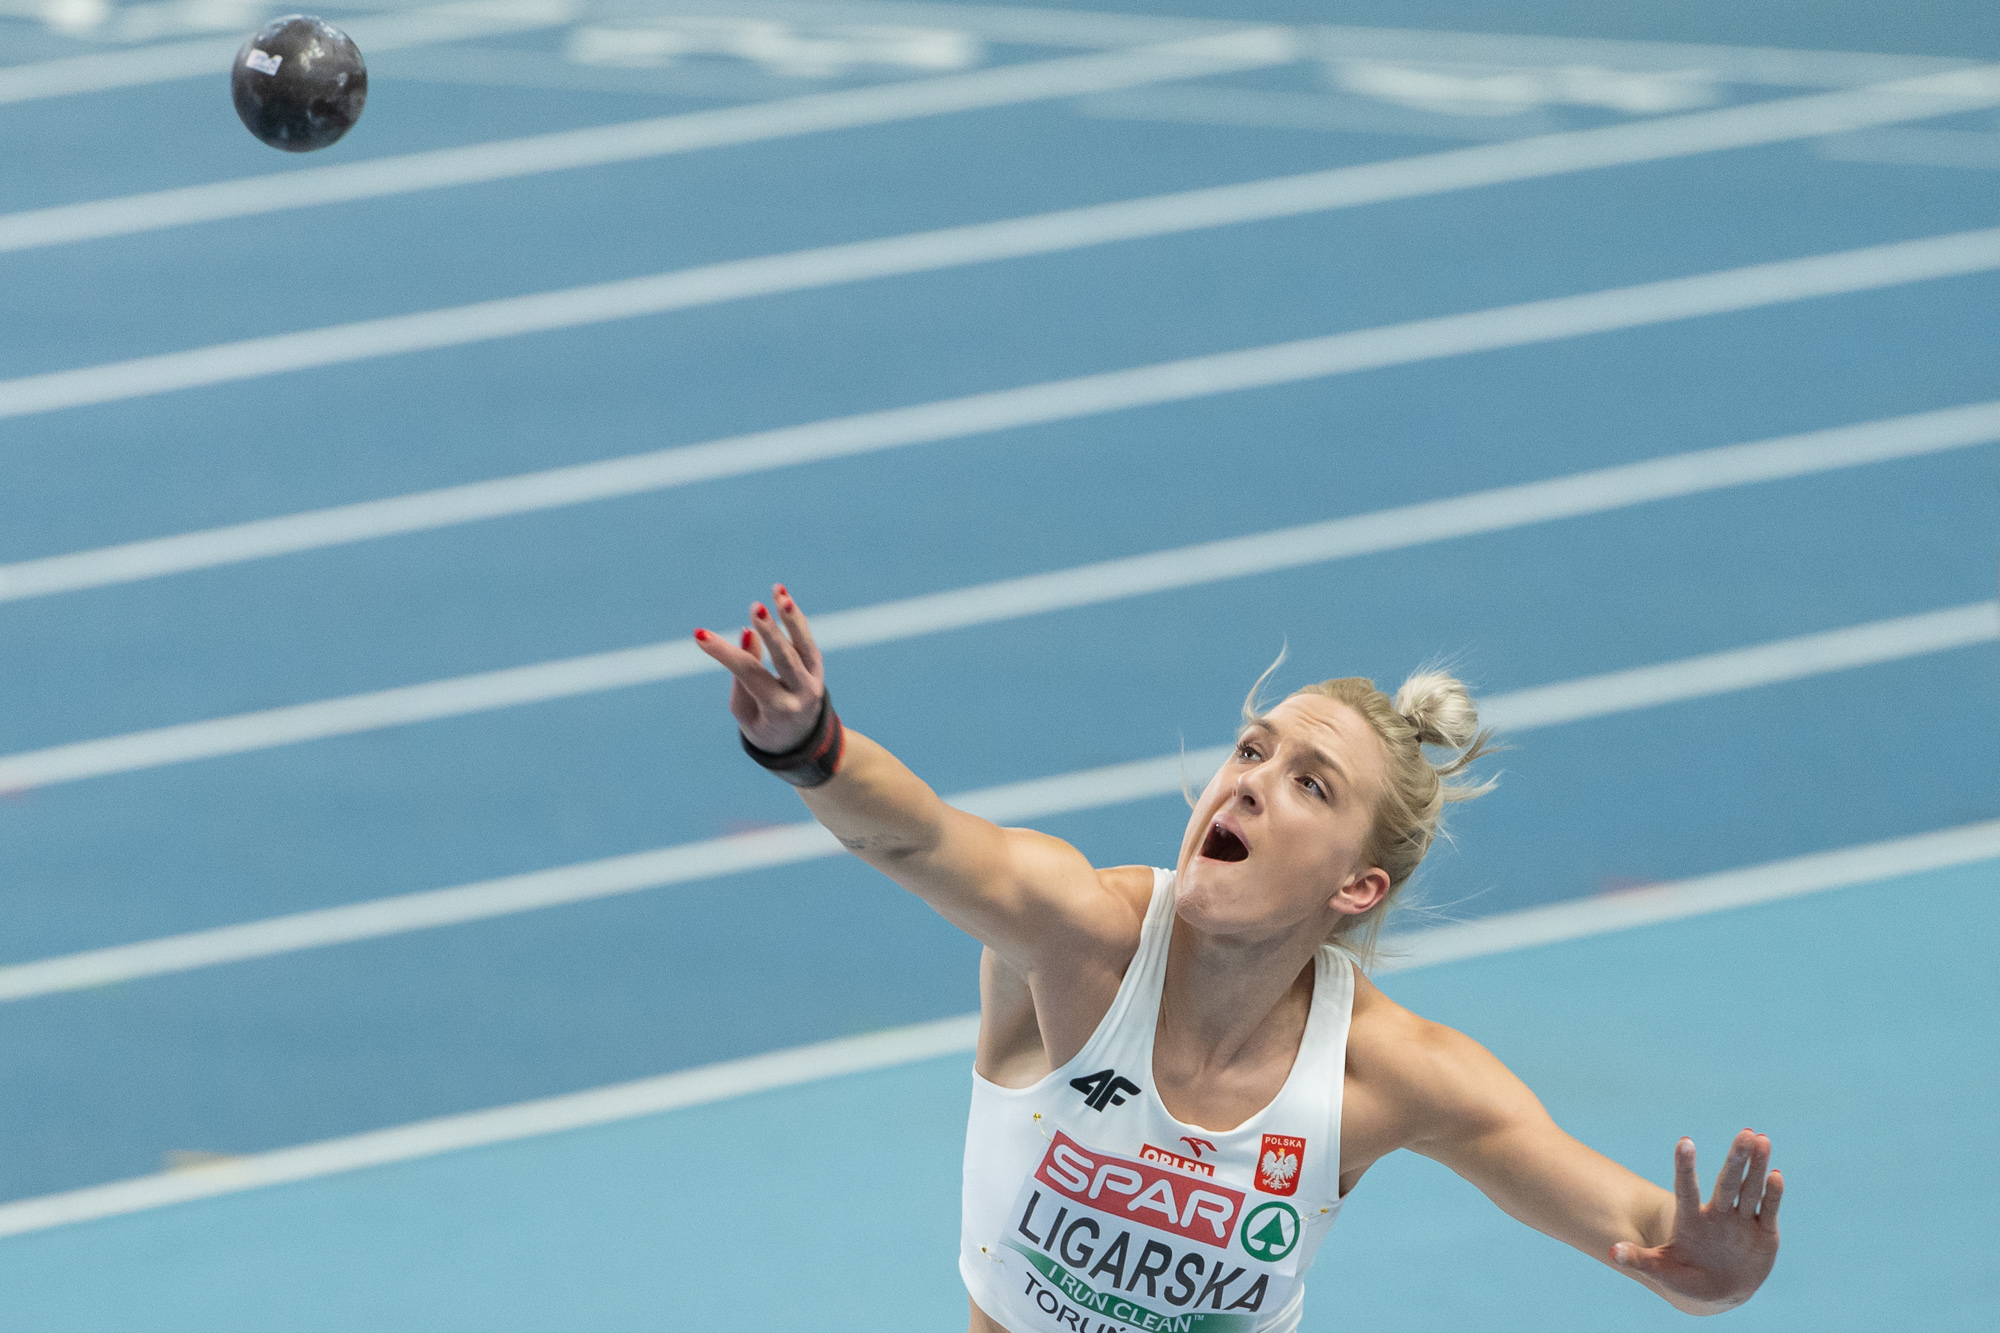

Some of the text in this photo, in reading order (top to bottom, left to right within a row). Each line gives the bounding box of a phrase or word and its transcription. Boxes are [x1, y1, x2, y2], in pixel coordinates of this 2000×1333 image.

[1265, 1136, 1302, 1148] POLSKA
[1046, 1143, 1235, 1239] SPAR
[1018, 1190, 1270, 1313] LIGARSKA
[1048, 1264, 1059, 1278] I
[1060, 1272, 1110, 1311] RUN
